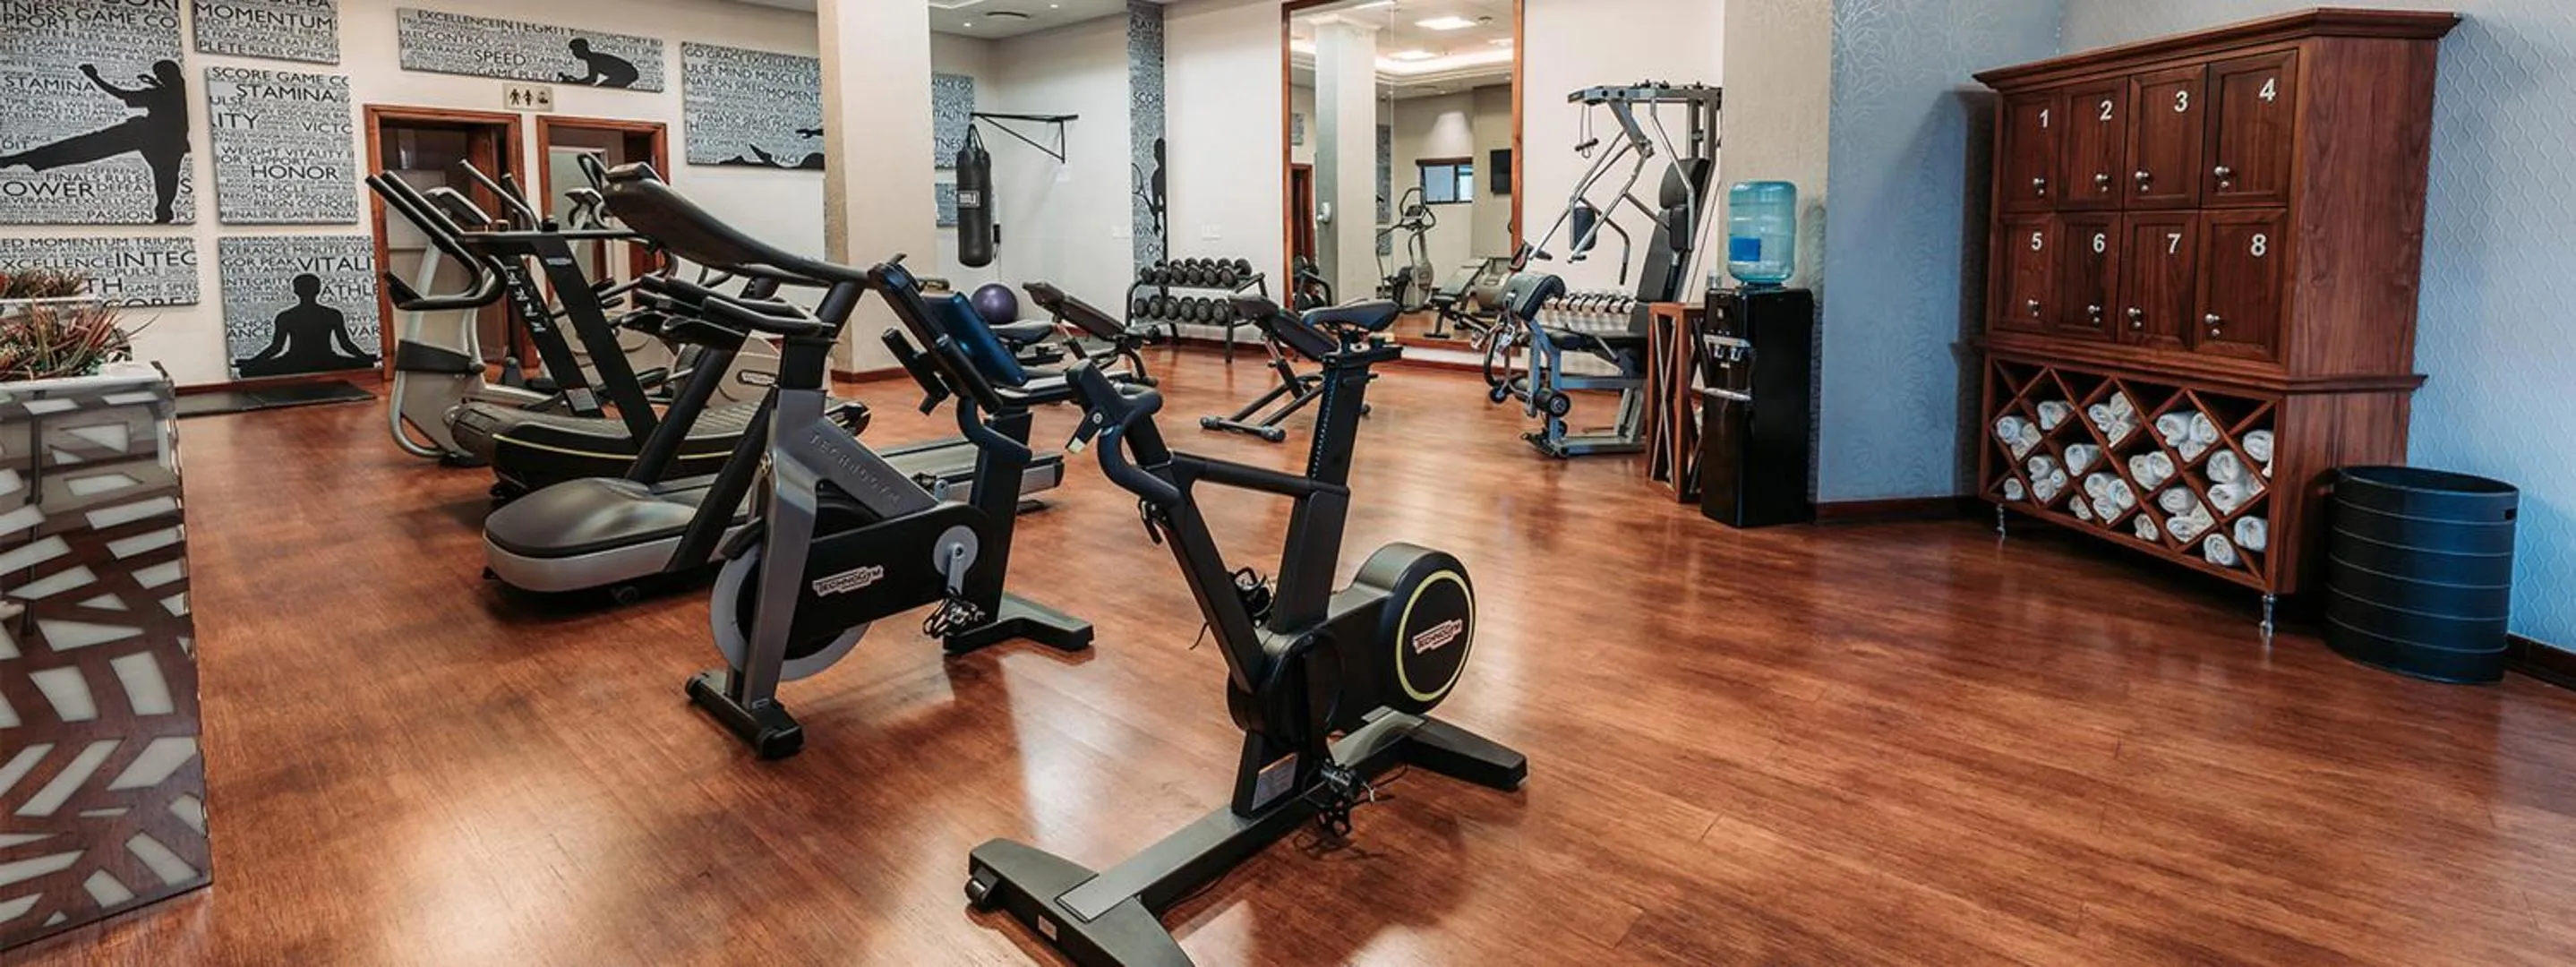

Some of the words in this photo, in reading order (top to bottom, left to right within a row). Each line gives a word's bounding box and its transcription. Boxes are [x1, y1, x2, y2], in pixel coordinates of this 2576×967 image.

[75, 8, 136, 24] GAME
[195, 3, 332, 30] MOMENTUM
[417, 9, 495, 29] EXCELLENCE
[474, 48, 526, 66] SPEED
[685, 47, 703, 57] GO
[4, 76, 96, 91] STAMINA
[212, 66, 271, 81] SCORE
[277, 72, 324, 85] GAME
[718, 66, 753, 79] MIND
[756, 72, 802, 86] MUSCLE
[236, 84, 337, 102] STAMINA
[2258, 77, 2277, 102] 4
[2099, 99, 2114, 122] 2
[2173, 90, 2189, 114] 3
[211, 112, 260, 130] ITY
[2040, 108, 2050, 129] 1
[221, 146, 279, 156] WEIGHT
[286, 149, 344, 158] VITALITY
[248, 156, 309, 166] SUPPORT
[46, 173, 99, 183] FINALS
[105, 175, 151, 183] RULES
[251, 165, 339, 179] HONOR
[3, 181, 95, 197] OWER
[97, 183, 153, 193] DEFEAT
[252, 184, 306, 193] MUSCLE
[87, 210, 153, 221] PASSION
[3, 238, 25, 247] ED
[30, 238, 129, 247] MOMENTUM
[2031, 231, 2043, 252] 5
[2092, 232, 2106, 253] 6
[2167, 232, 2182, 255] 7
[2249, 233, 2267, 258] 8
[261, 257, 296, 267] PEAK
[296, 256, 371, 272] VITALI
[124, 284, 161, 293] GAME
[814, 566, 883, 595] TECHNOGYM
